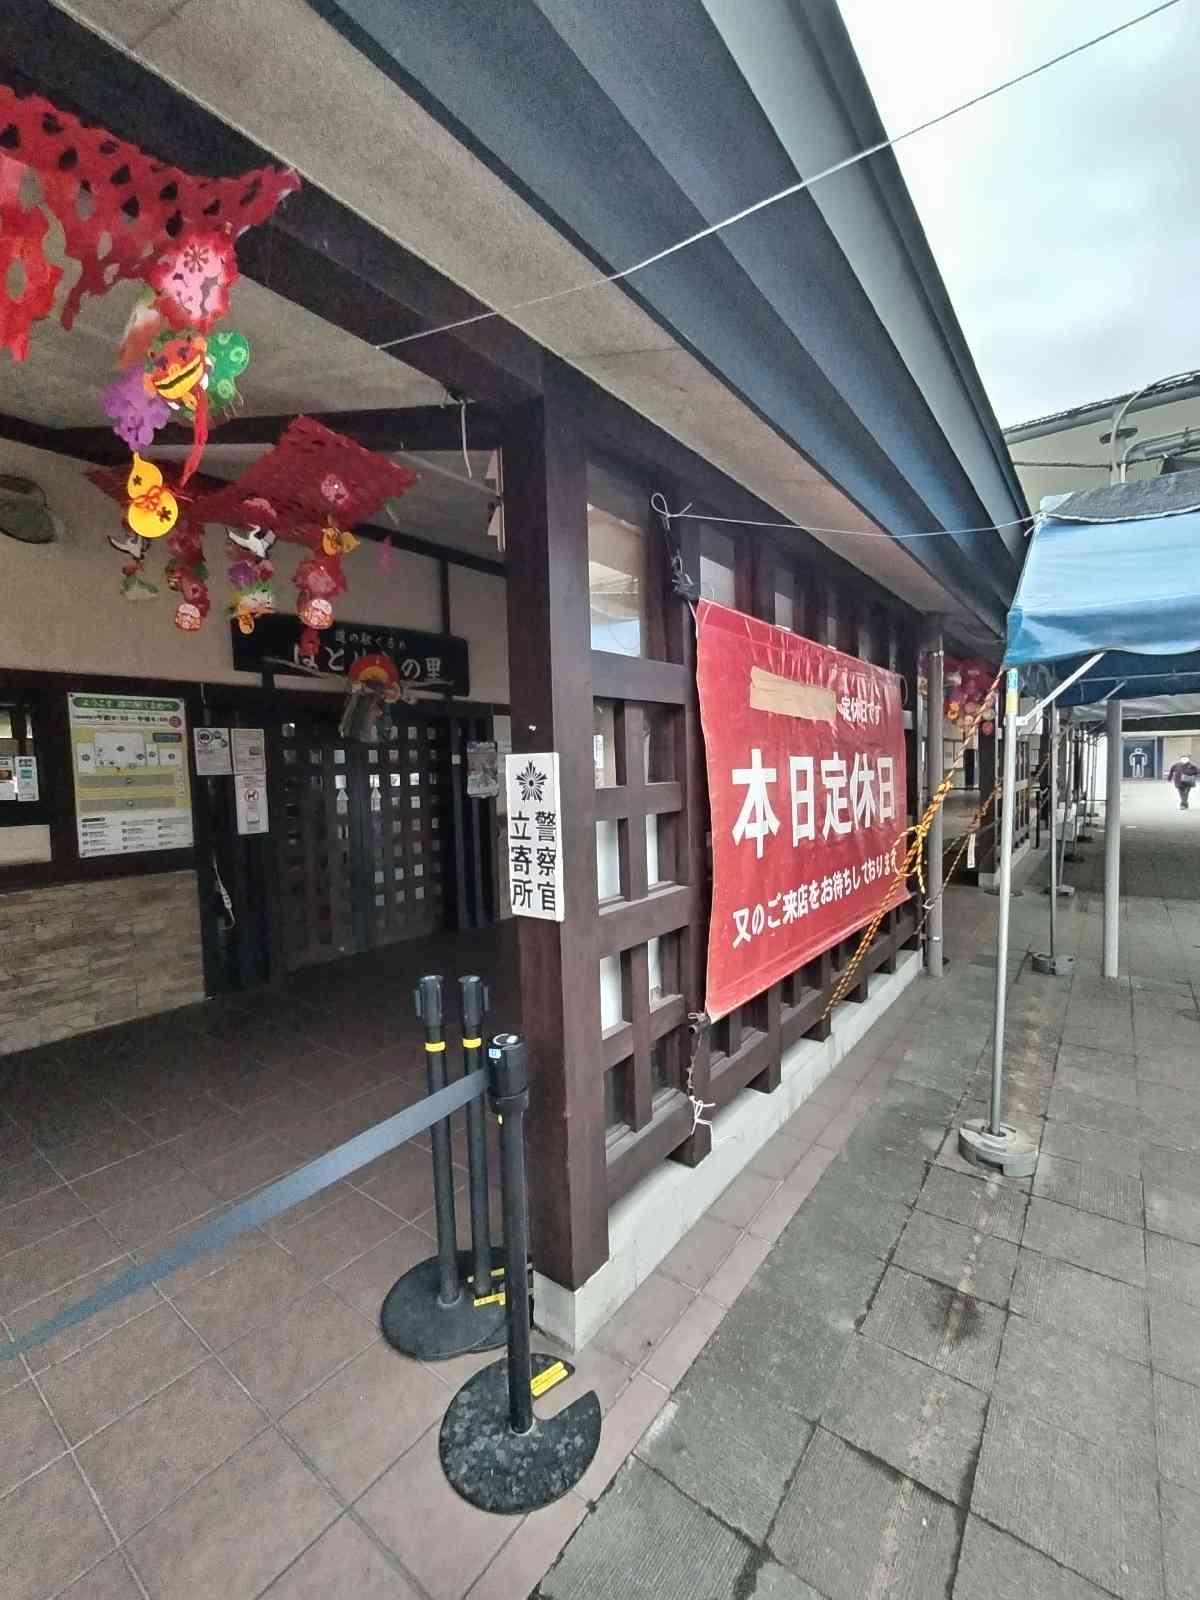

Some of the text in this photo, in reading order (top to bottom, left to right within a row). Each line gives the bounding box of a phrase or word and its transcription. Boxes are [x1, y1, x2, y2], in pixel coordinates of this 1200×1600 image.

[731, 748, 896, 859] 本日定休日
[510, 810, 533, 909] 立寄所
[535, 810, 557, 912] 警察官
